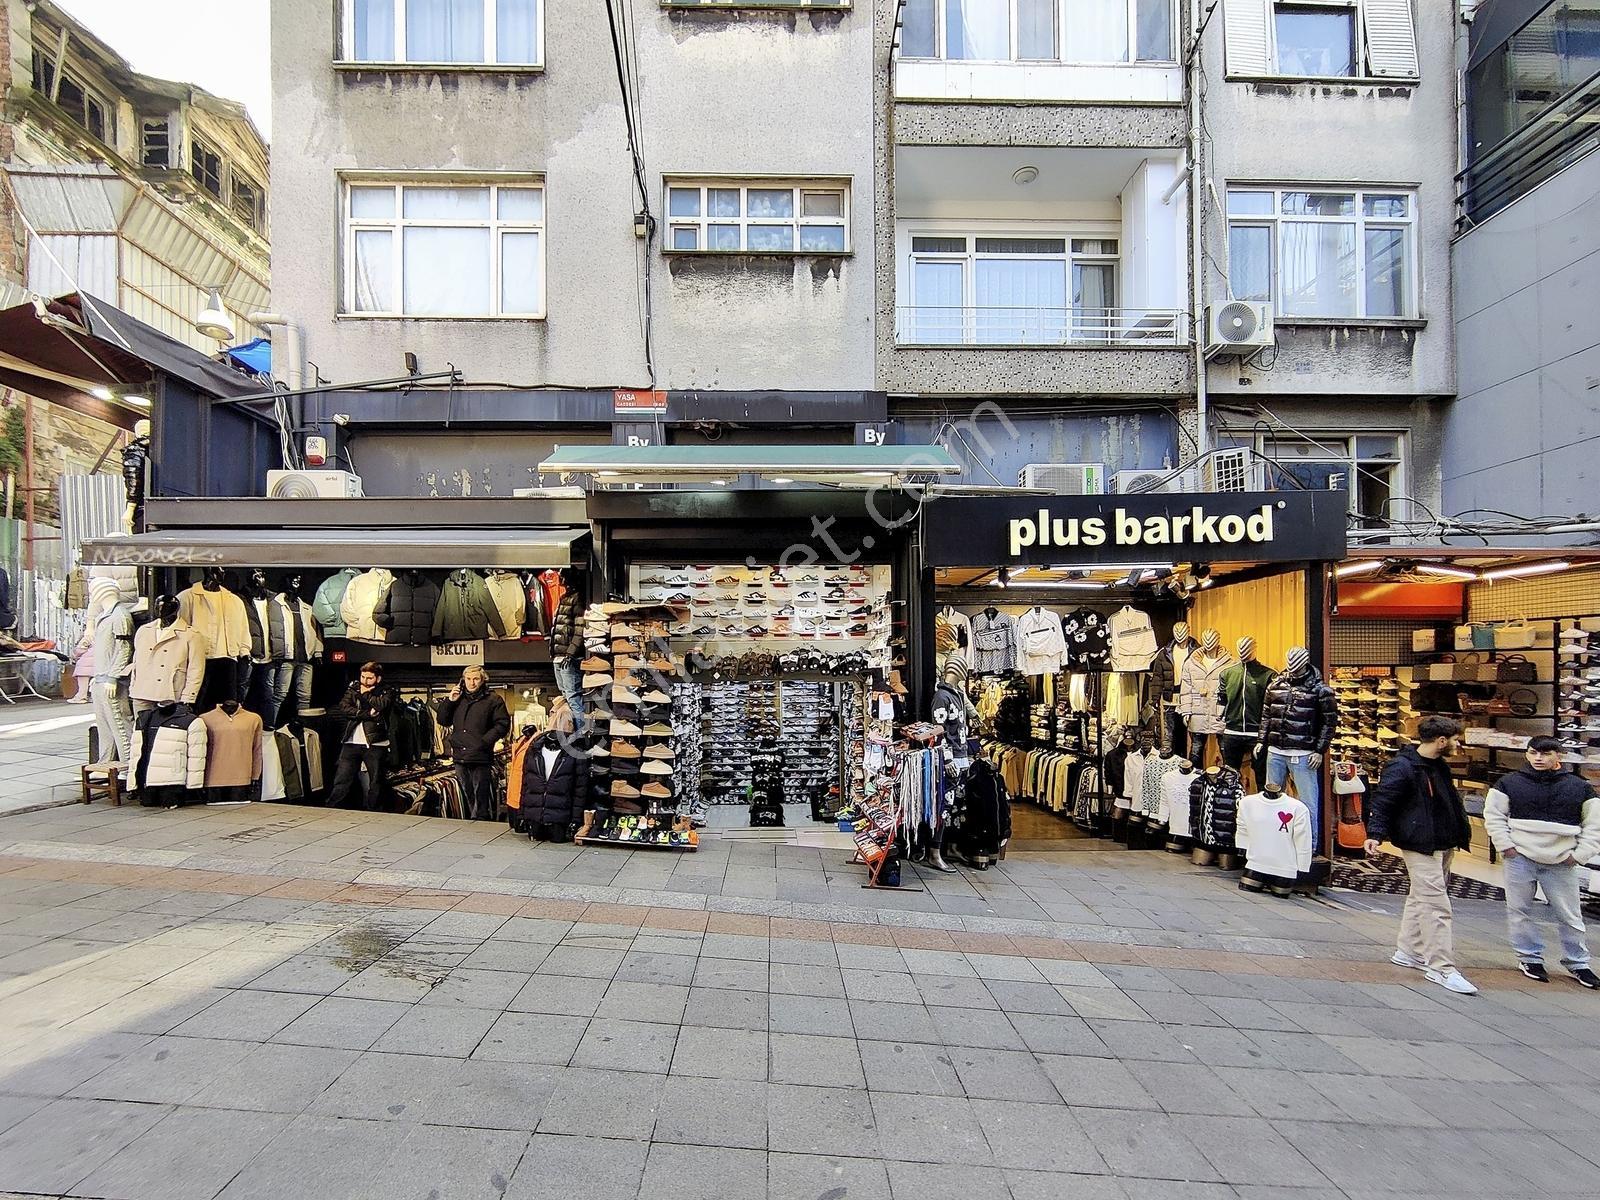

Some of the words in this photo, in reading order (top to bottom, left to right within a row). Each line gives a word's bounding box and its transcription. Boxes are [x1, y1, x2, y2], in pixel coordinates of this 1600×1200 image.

[864, 428, 886, 446] By
[1009, 508, 1107, 556] plus
[1114, 504, 1274, 545] barkod
